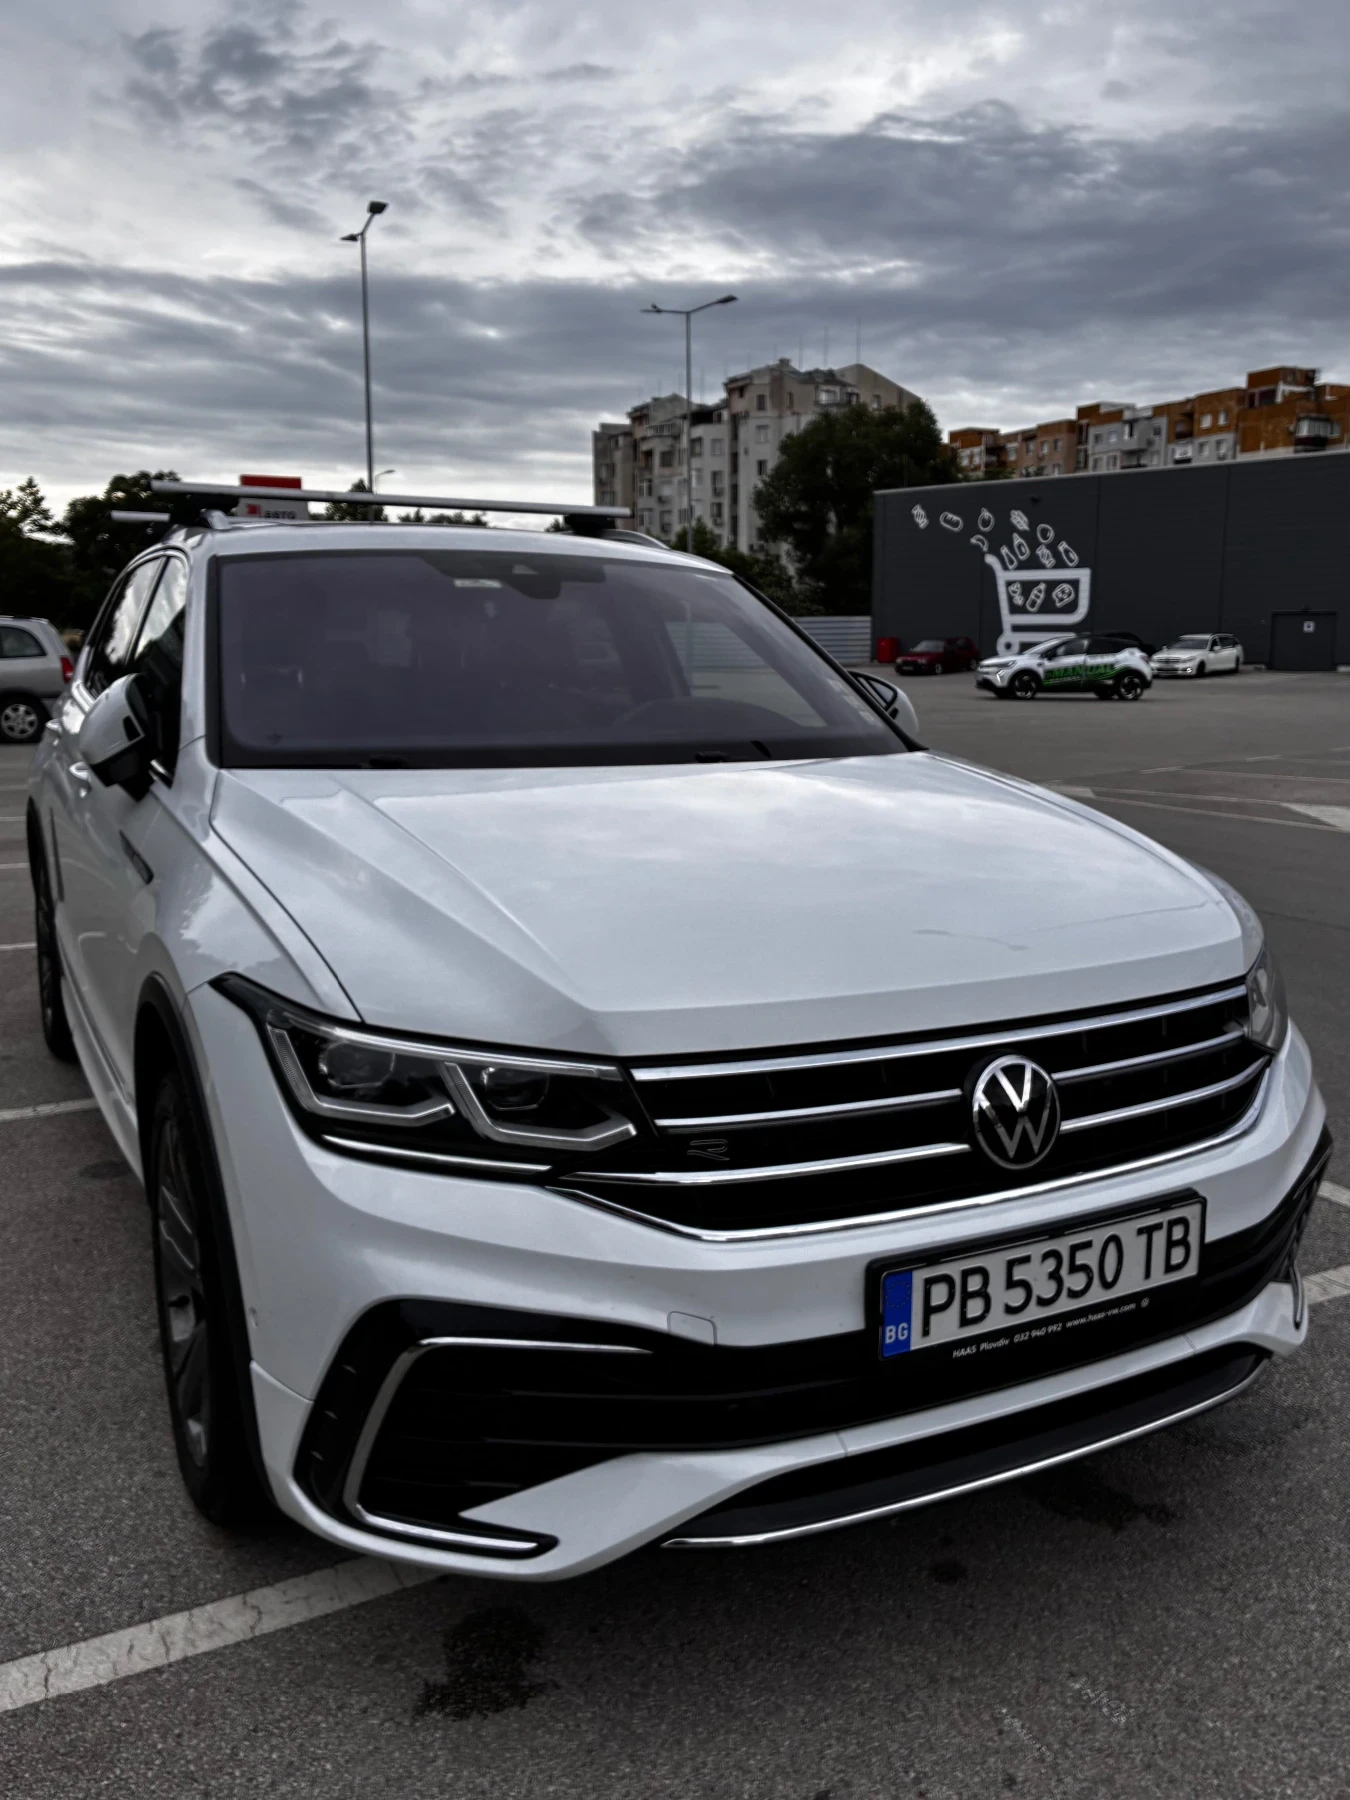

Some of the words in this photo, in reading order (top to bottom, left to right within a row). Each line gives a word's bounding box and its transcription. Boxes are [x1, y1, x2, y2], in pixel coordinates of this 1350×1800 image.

[921, 1263, 993, 1338] PB
[1003, 1232, 1124, 1316] 5350
[1136, 1215, 1192, 1281] TB
[884, 1323, 909, 1345] BG
[952, 1345, 977, 1359] HAAS
